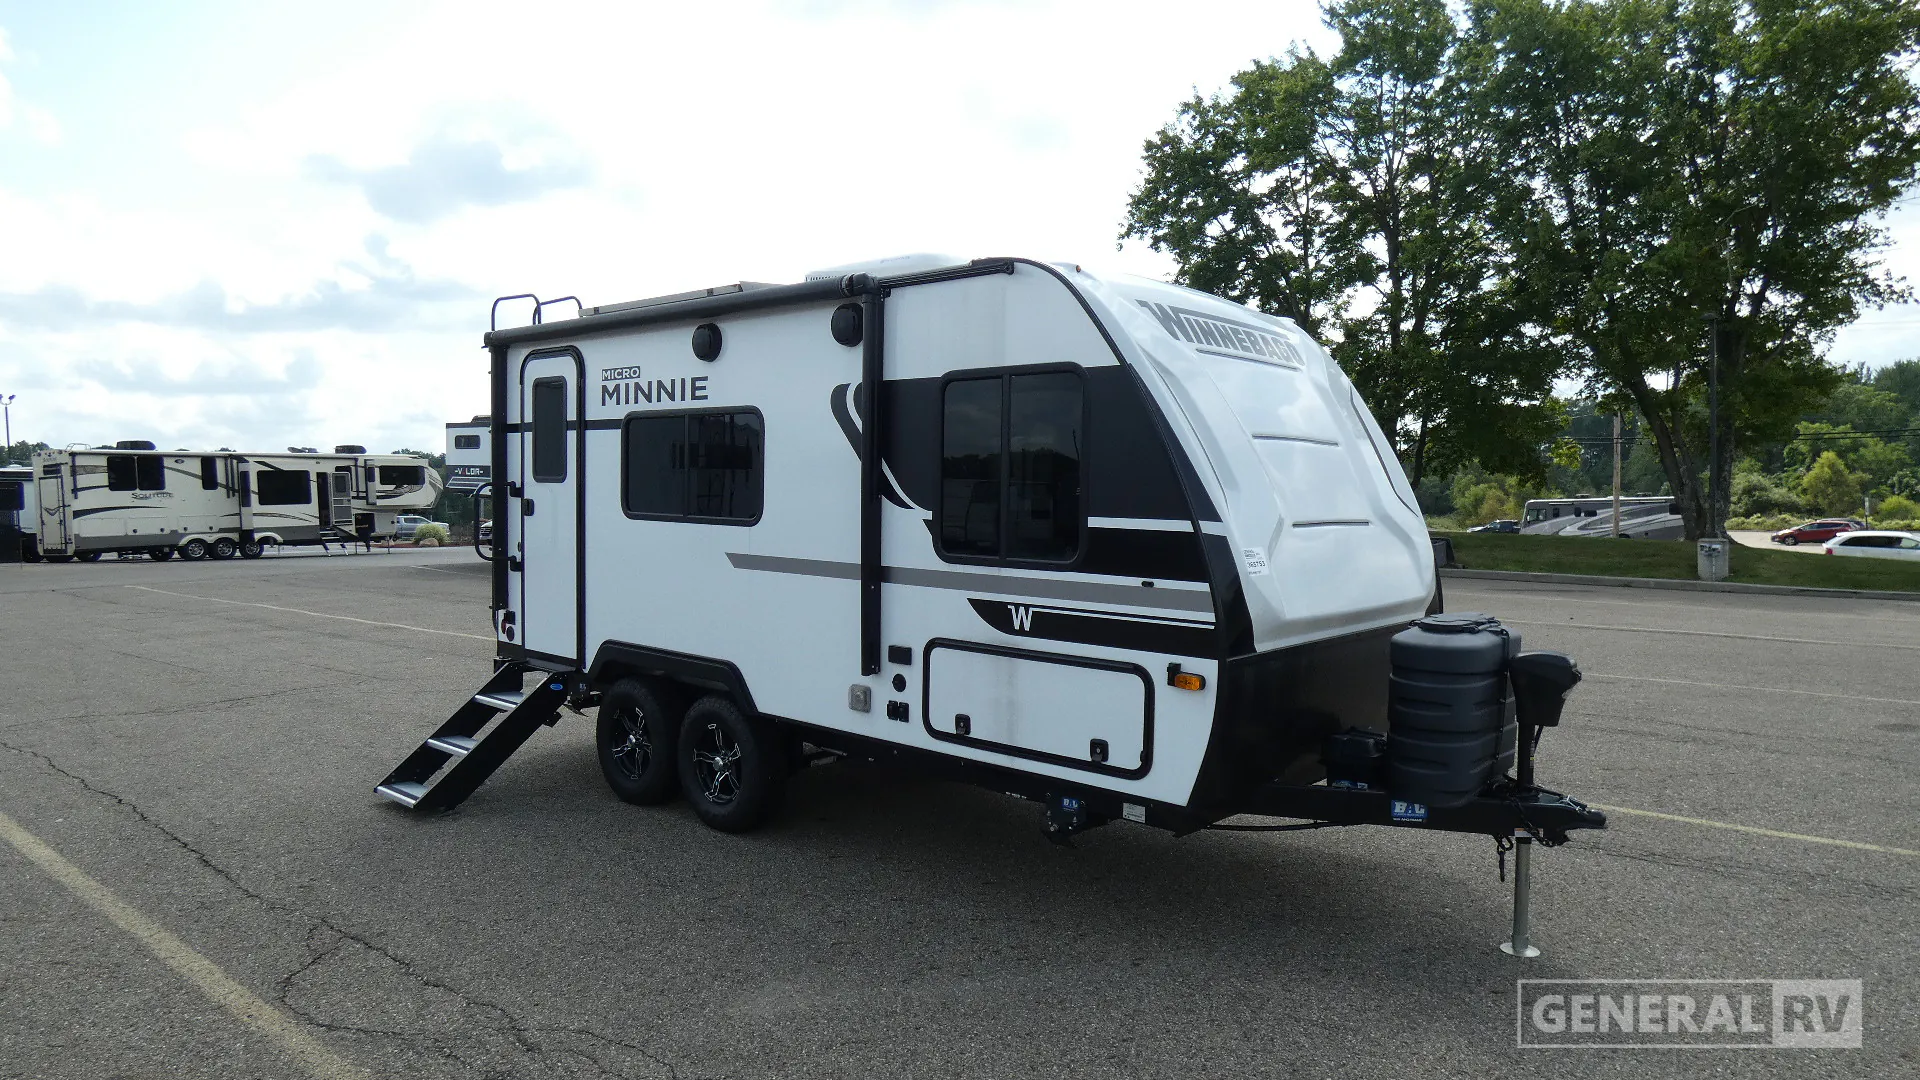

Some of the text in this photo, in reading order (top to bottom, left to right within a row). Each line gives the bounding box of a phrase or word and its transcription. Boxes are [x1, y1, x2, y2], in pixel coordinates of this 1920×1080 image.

[1135, 299, 1305, 366] WINNEBAGO
[602, 367, 640, 380] MICRO
[601, 376, 709, 406] MINNIE
[1007, 604, 1033, 631] W
